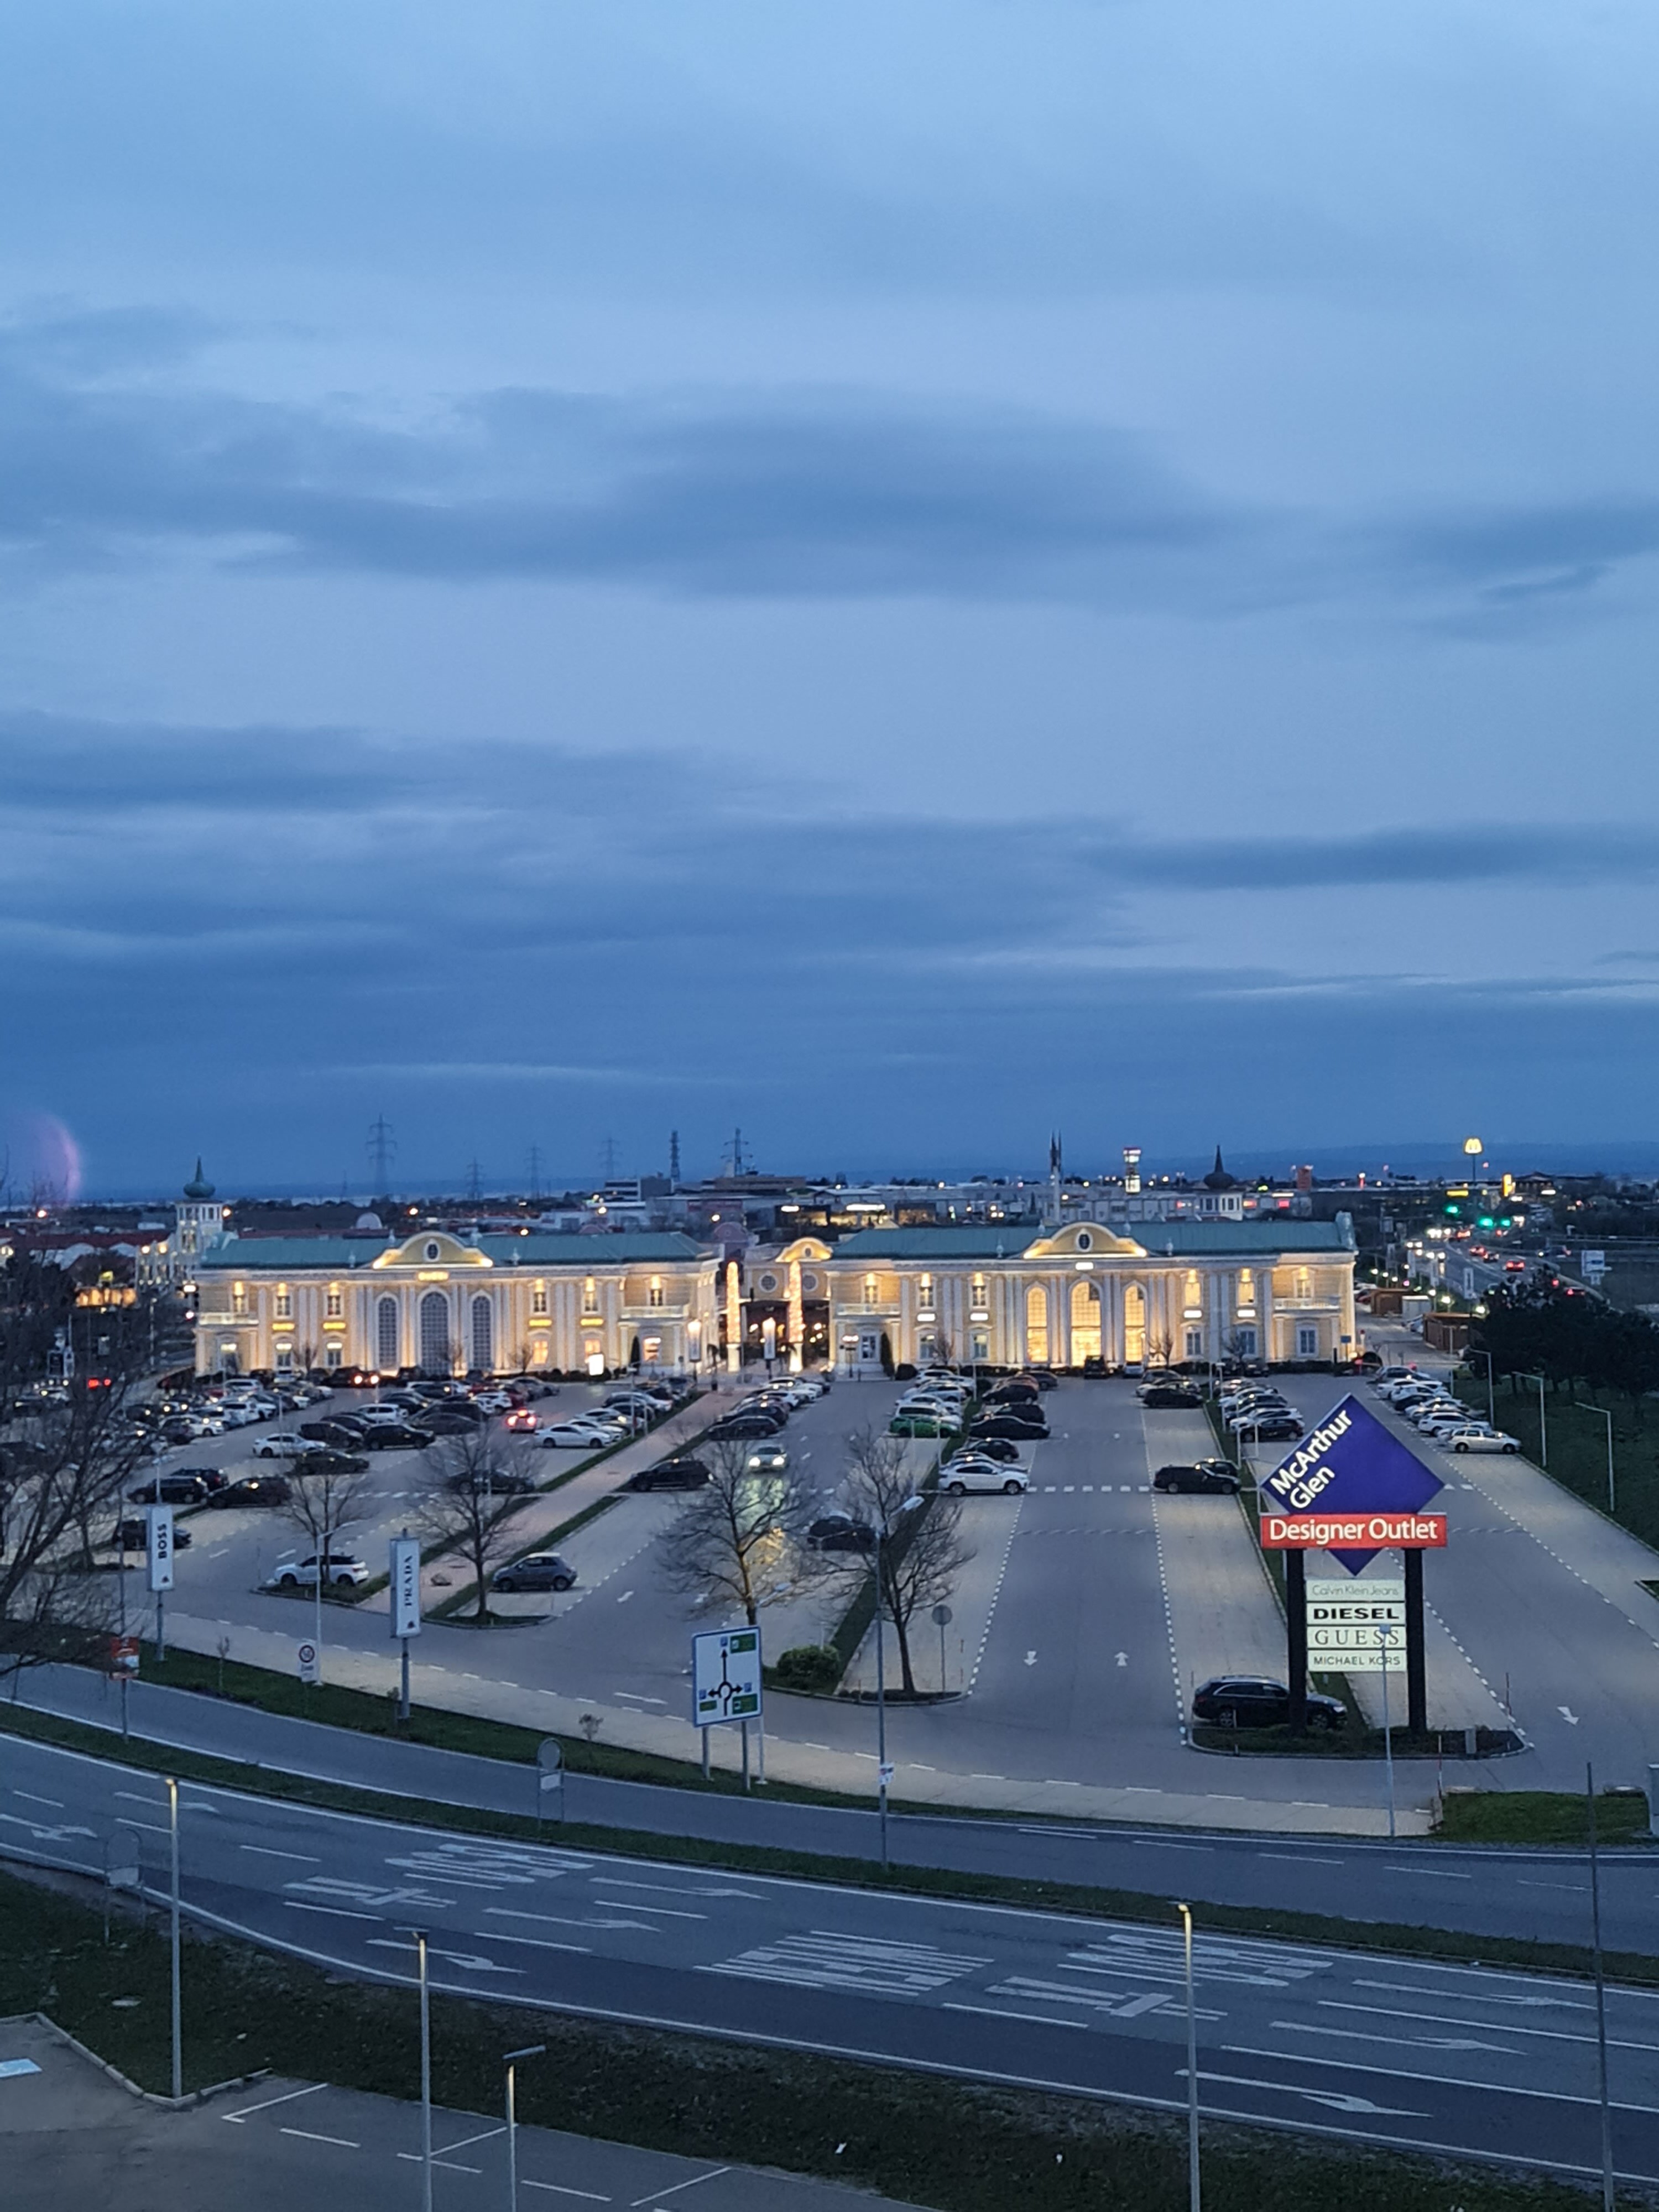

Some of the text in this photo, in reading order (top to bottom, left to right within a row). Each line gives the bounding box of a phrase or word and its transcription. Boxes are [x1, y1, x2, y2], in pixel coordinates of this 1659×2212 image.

[1270, 1410, 1352, 1495] McArthur
[1290, 1467, 1335, 1509] Glen
[157, 1524, 168, 1559] BOSS
[1270, 1517, 1438, 1545] Designer Outlet
[404, 1555, 413, 1606] PRADA
[1313, 1608, 1400, 1620] DIESEL
[1314, 1630, 1399, 1645] GUESS
[1313, 1656, 1365, 1665] MICHAEL
